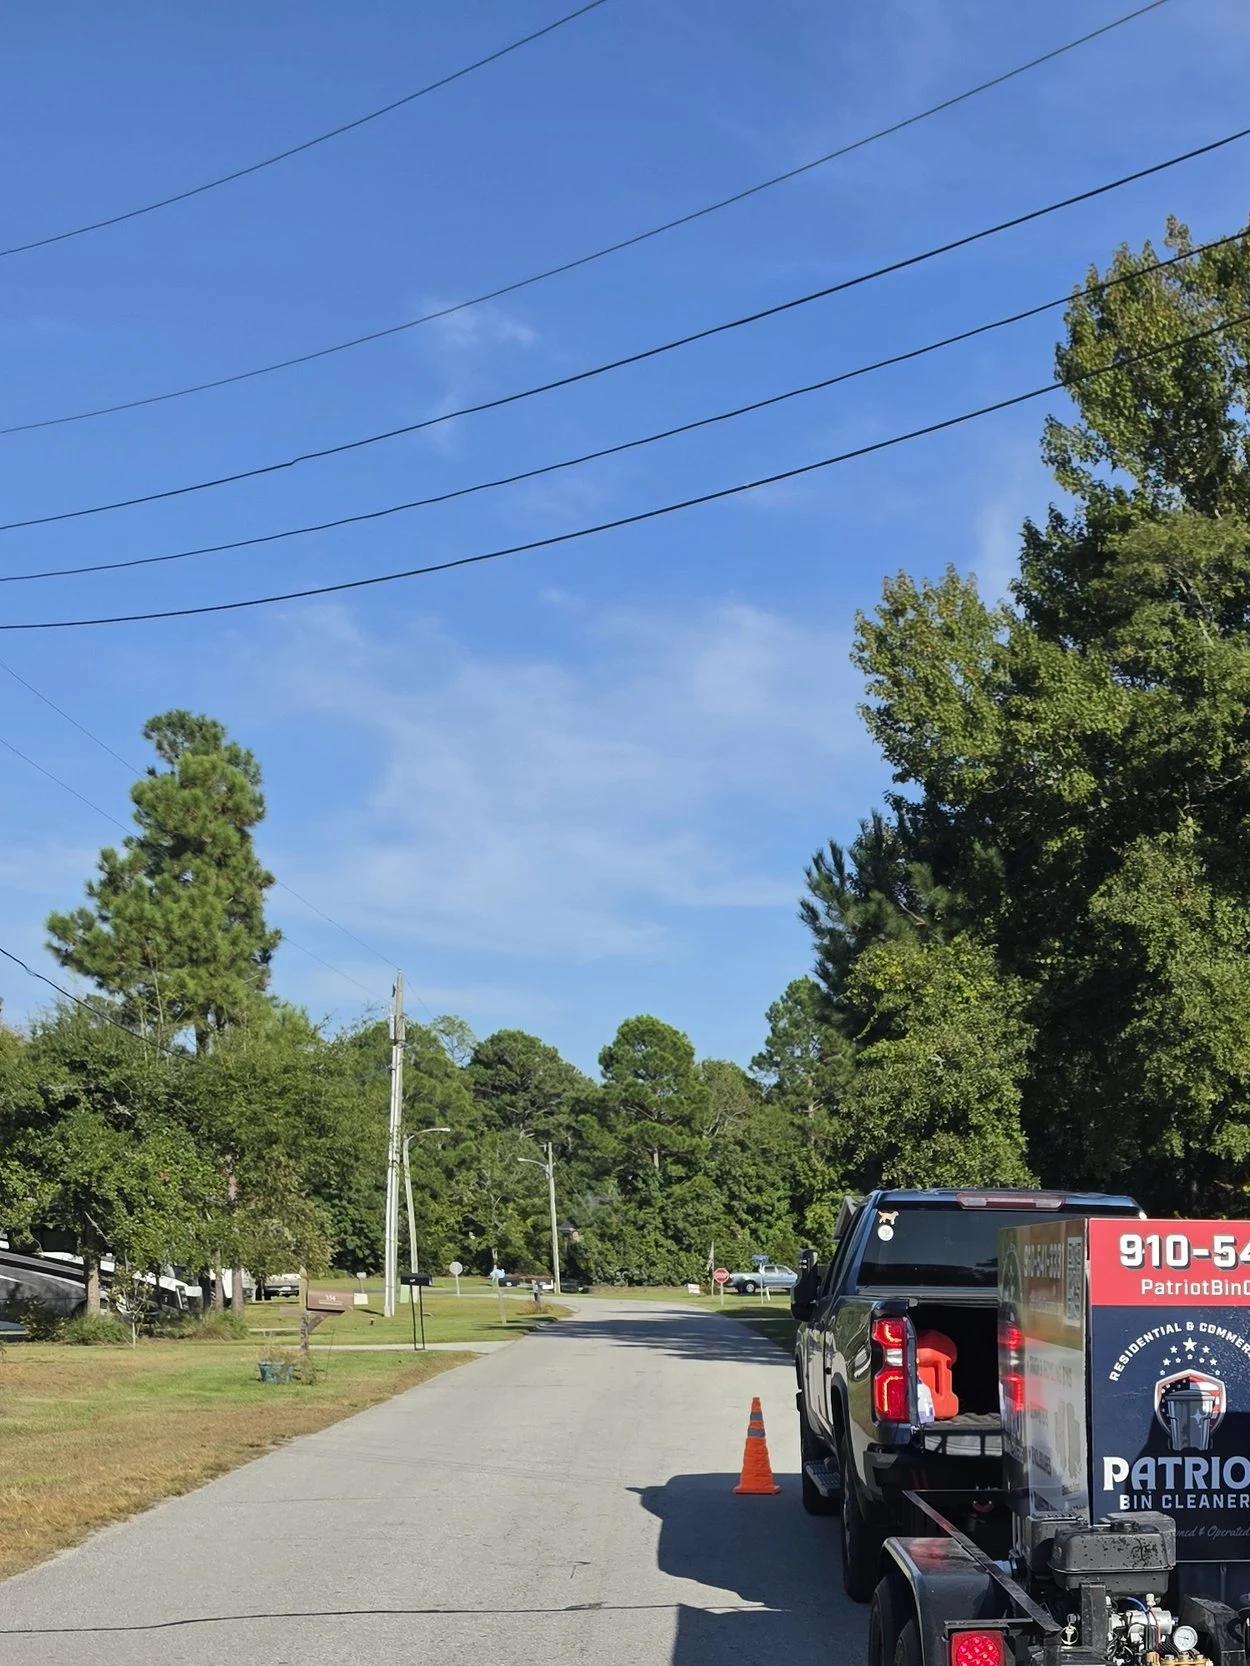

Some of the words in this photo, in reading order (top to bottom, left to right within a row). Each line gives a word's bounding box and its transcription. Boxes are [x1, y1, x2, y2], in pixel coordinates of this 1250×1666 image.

[1109, 1322, 1182, 1382] RESIDENTIAL
[1186, 1321, 1195, 1331] &
[1119, 1494, 1152, 1510] BIN
